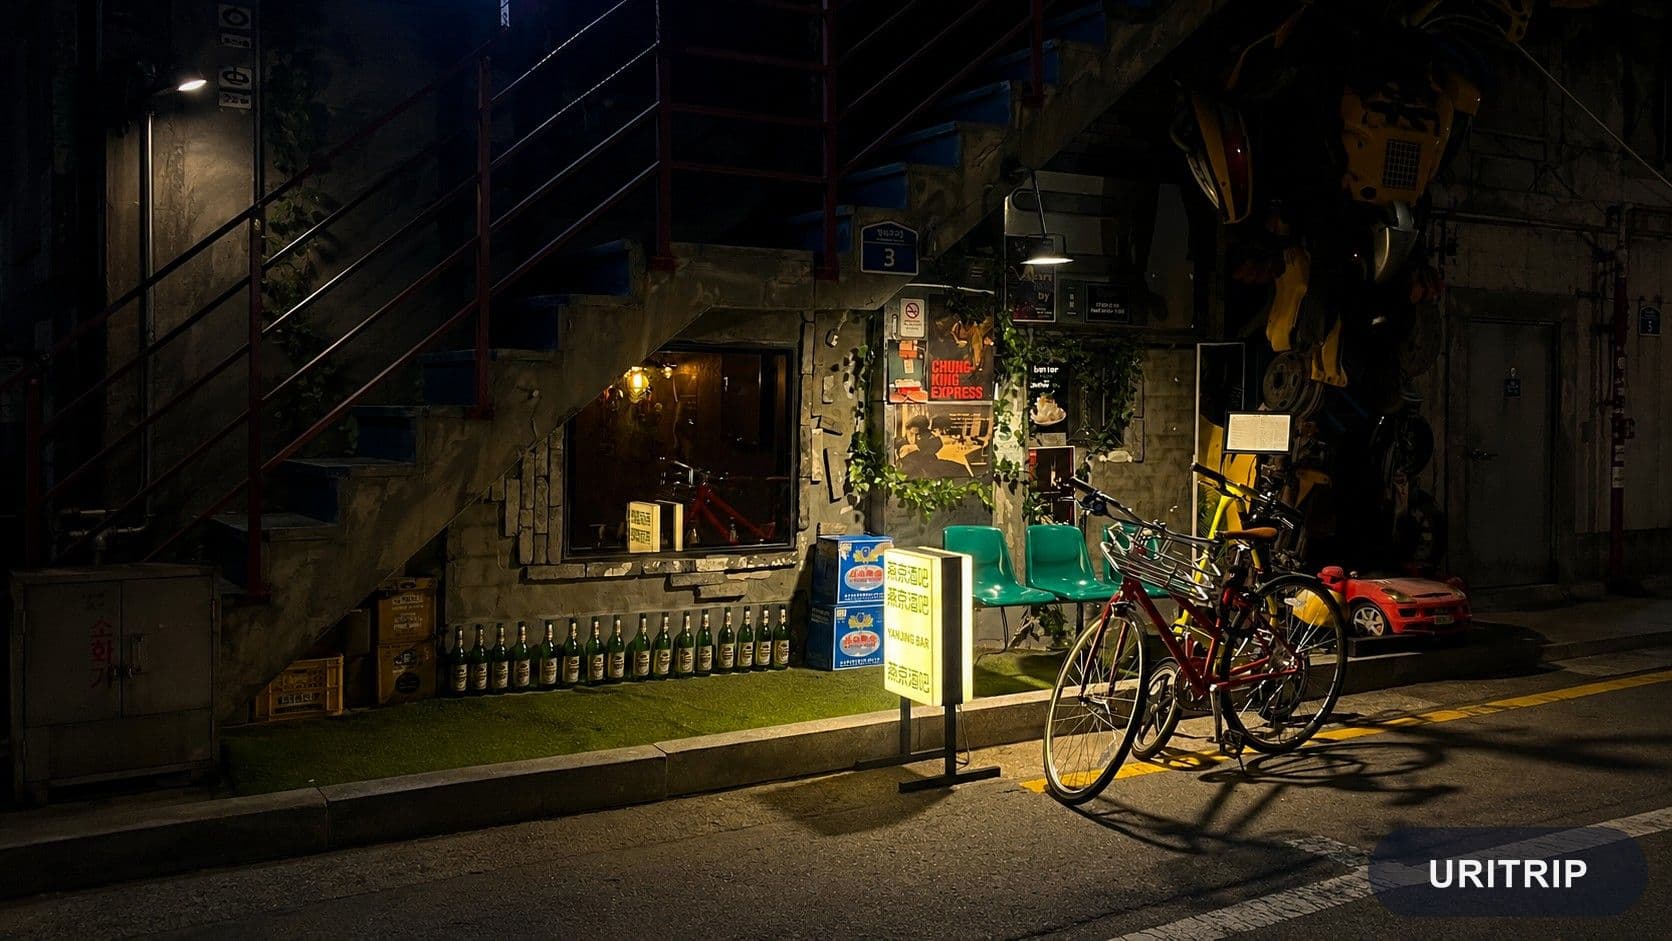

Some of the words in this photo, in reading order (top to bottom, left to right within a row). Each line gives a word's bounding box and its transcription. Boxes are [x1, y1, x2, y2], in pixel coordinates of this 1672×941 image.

[883, 247, 895, 267] 3
[931, 373, 960, 386] KING
[931, 386, 983, 400] EXPRESS
[887, 627, 915, 645] YANJING
[915, 635, 930, 649] BAR
[89, 619, 113, 688] 소화기
